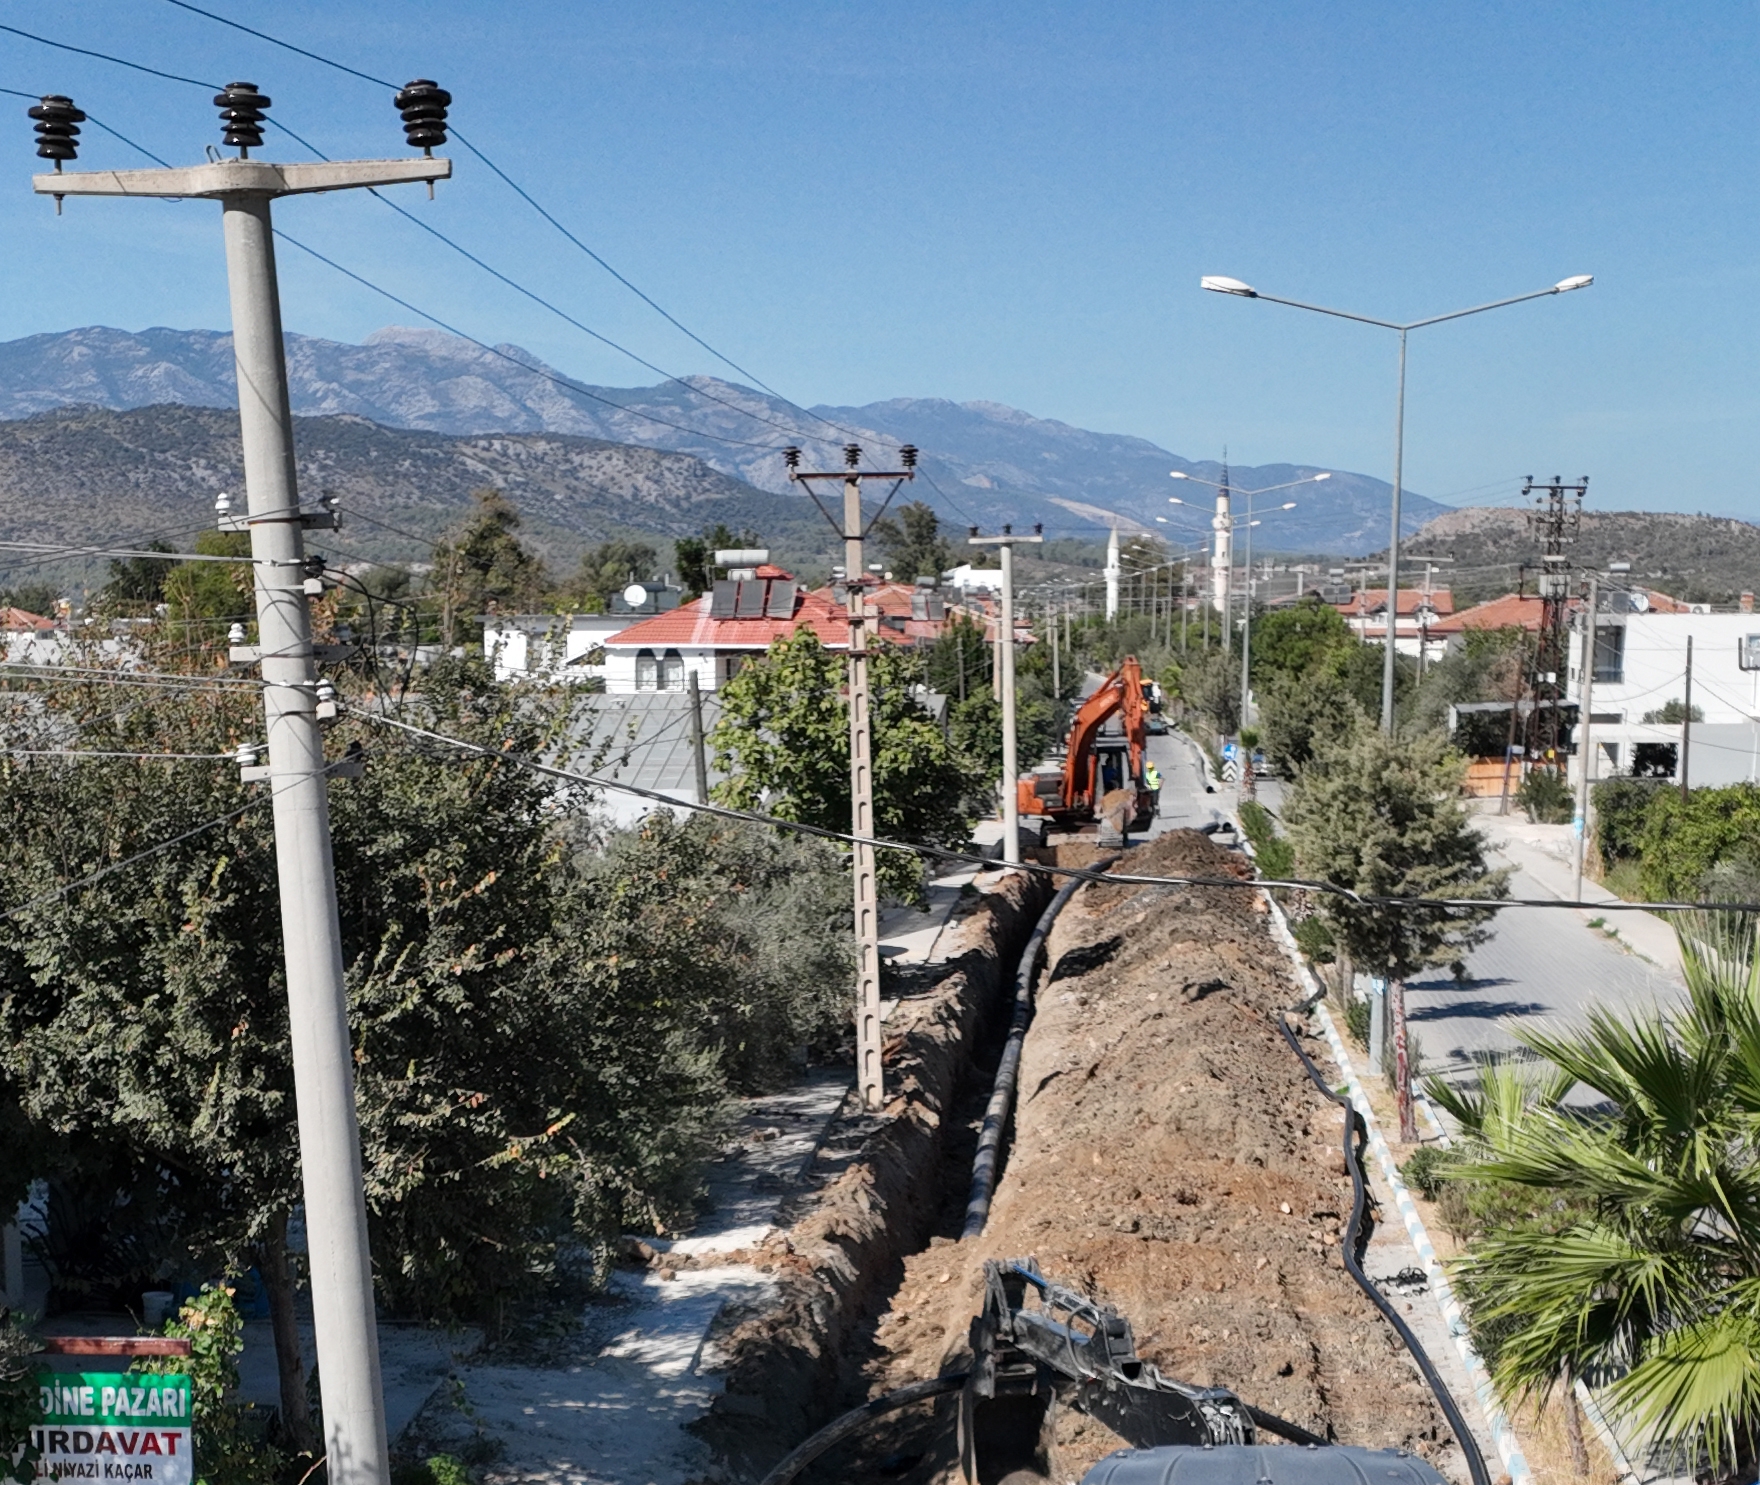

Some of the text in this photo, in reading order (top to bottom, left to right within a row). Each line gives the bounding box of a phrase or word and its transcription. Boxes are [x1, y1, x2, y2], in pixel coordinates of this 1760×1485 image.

[40, 1380, 186, 1418] DİNE PAZARI
[34, 1458, 153, 1483] Lİ NİYAZİ KAÇAR
